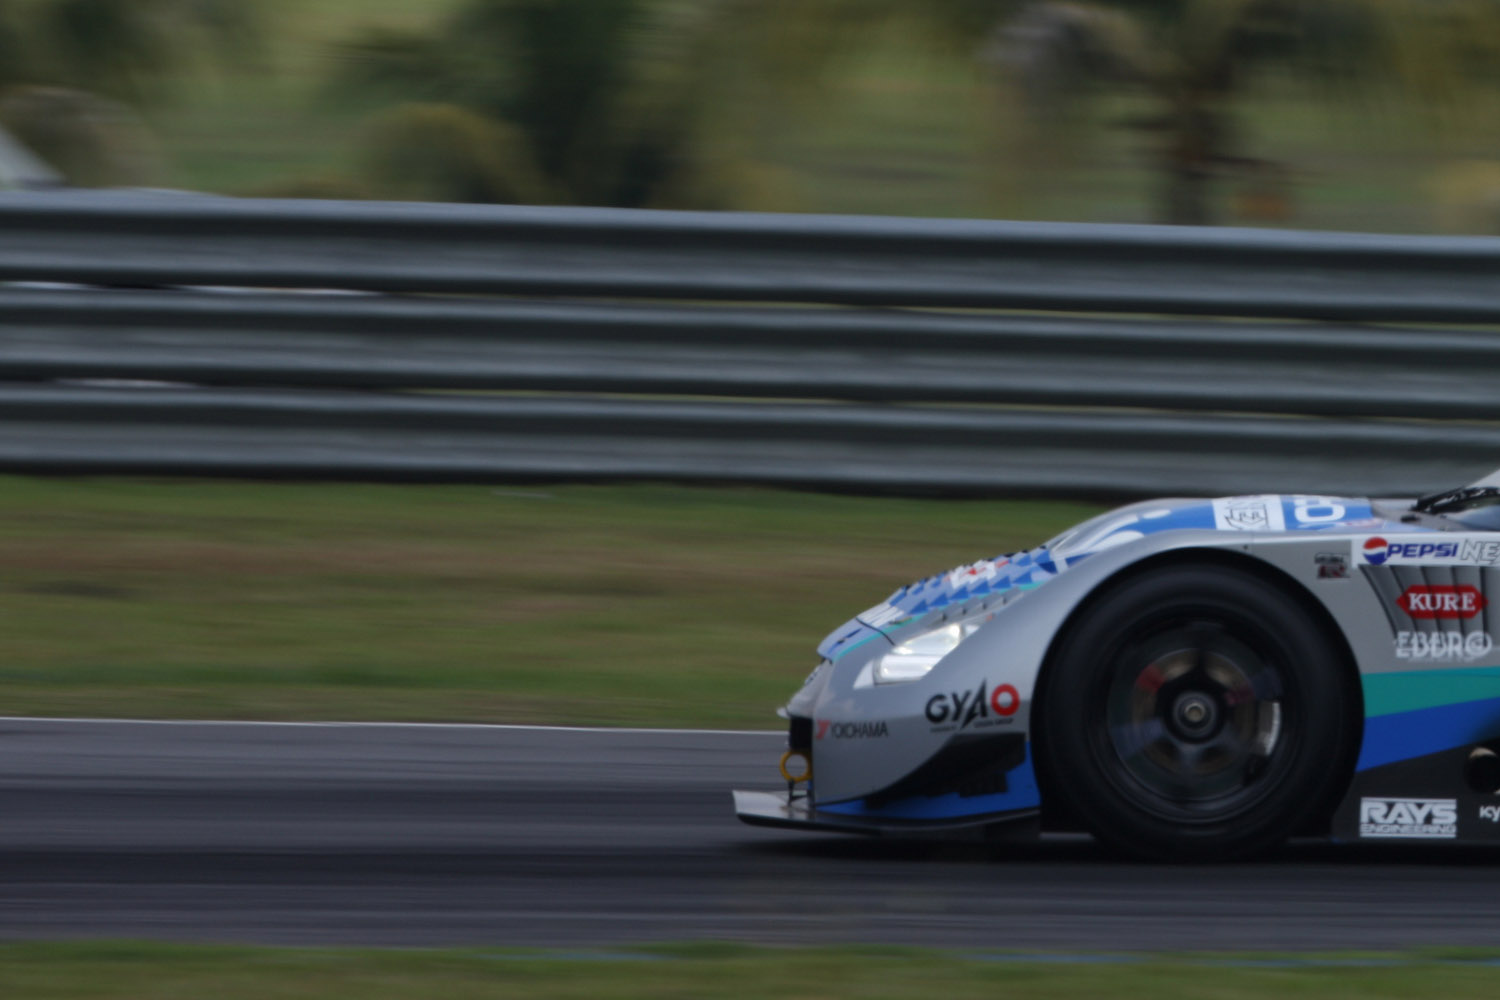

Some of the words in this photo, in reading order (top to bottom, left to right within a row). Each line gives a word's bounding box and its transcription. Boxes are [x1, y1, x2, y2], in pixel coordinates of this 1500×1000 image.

[1386, 542, 1459, 559] PEPSI
[1408, 591, 1477, 612] KURE
[830, 720, 889, 739] YOKOHAMA
[1360, 801, 1457, 824] RAYS
